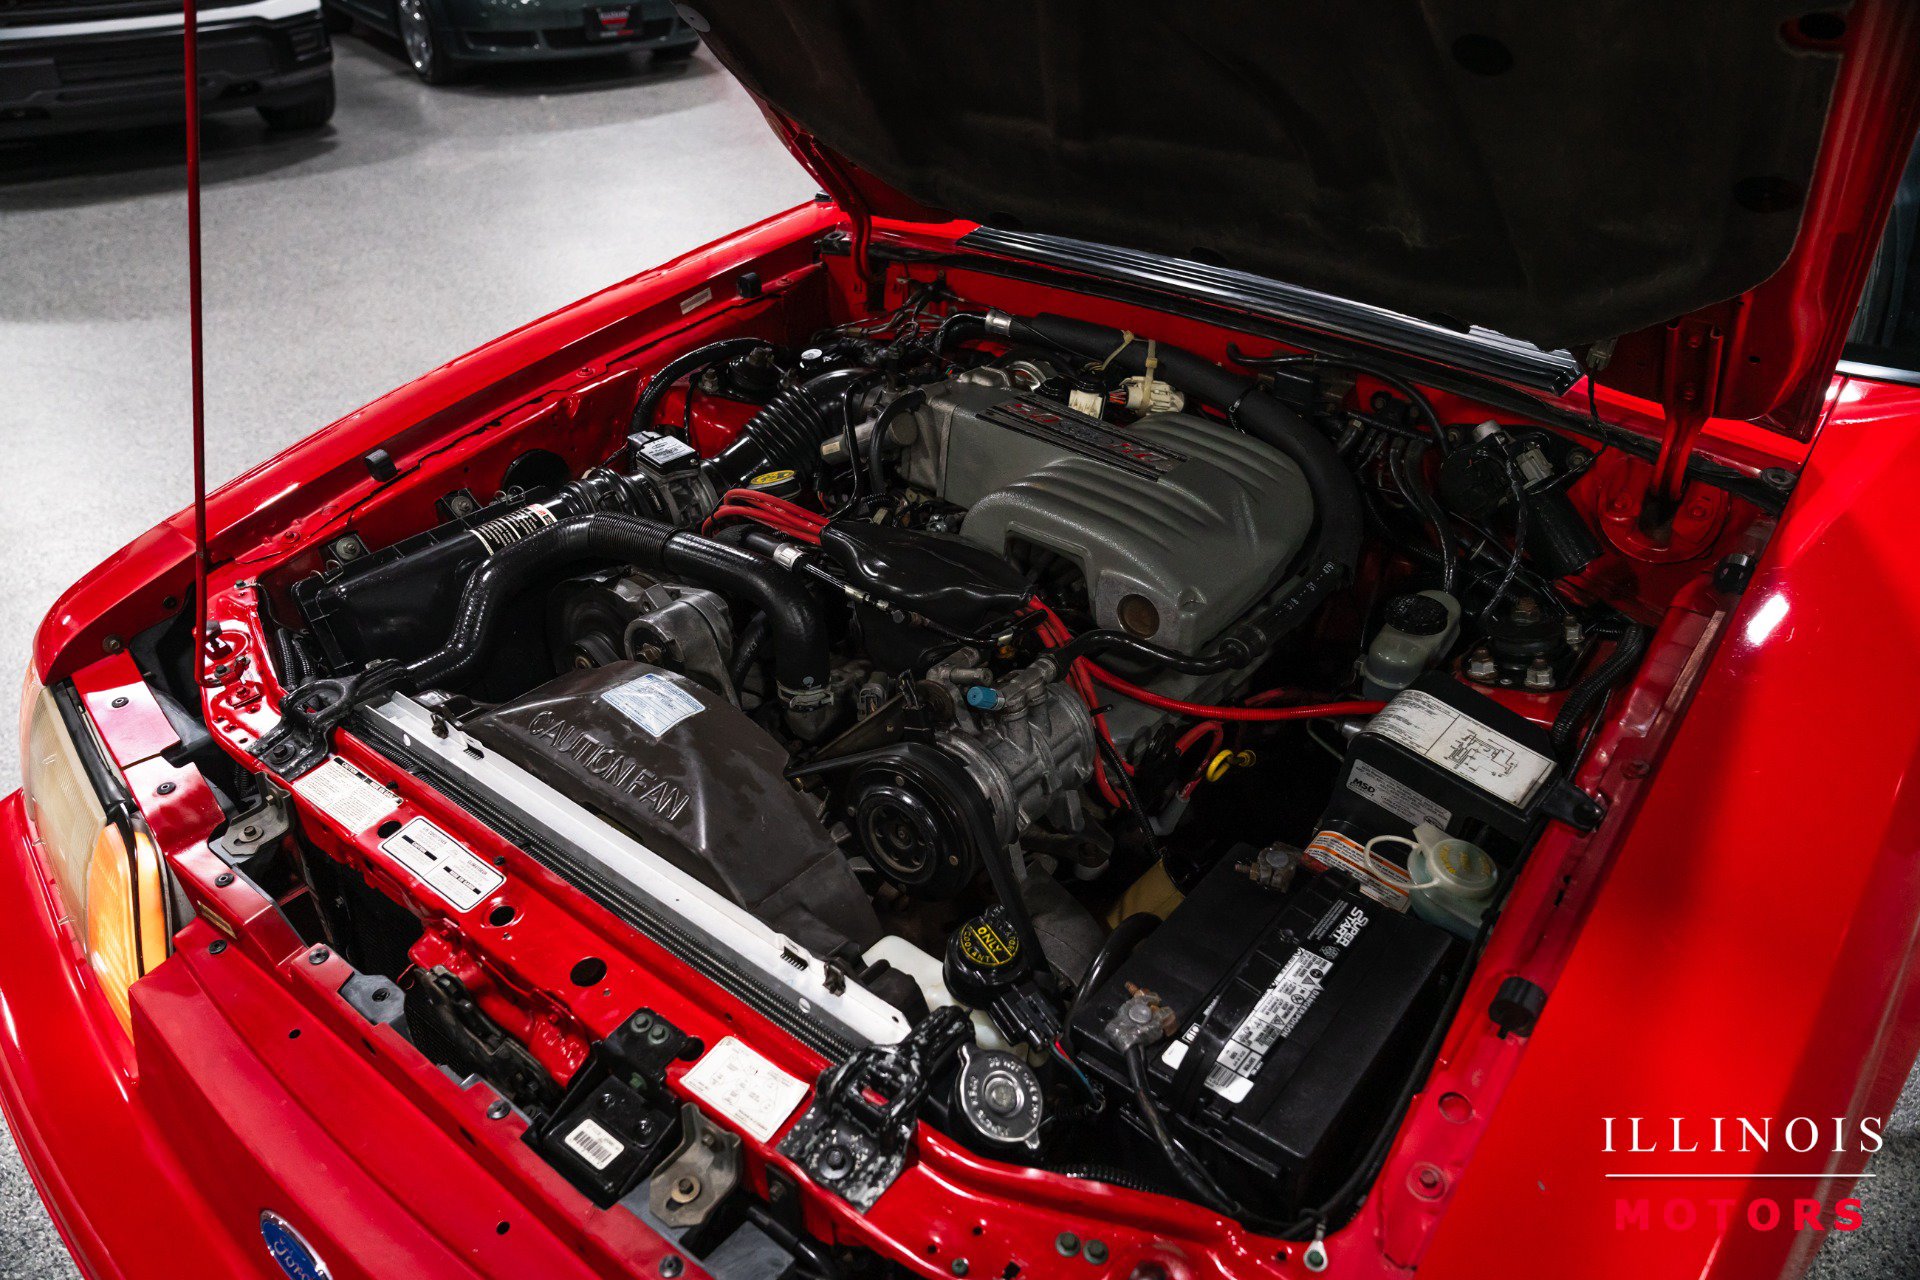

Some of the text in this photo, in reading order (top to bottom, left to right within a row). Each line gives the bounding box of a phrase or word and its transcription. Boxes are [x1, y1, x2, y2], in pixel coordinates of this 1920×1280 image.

[528, 708, 689, 821] CAUTION FAN
[1352, 777, 1376, 794] MSD
[976, 925, 1002, 953] ONLY
[1332, 906, 1364, 942] START
[1340, 914, 1369, 947] SUPER
